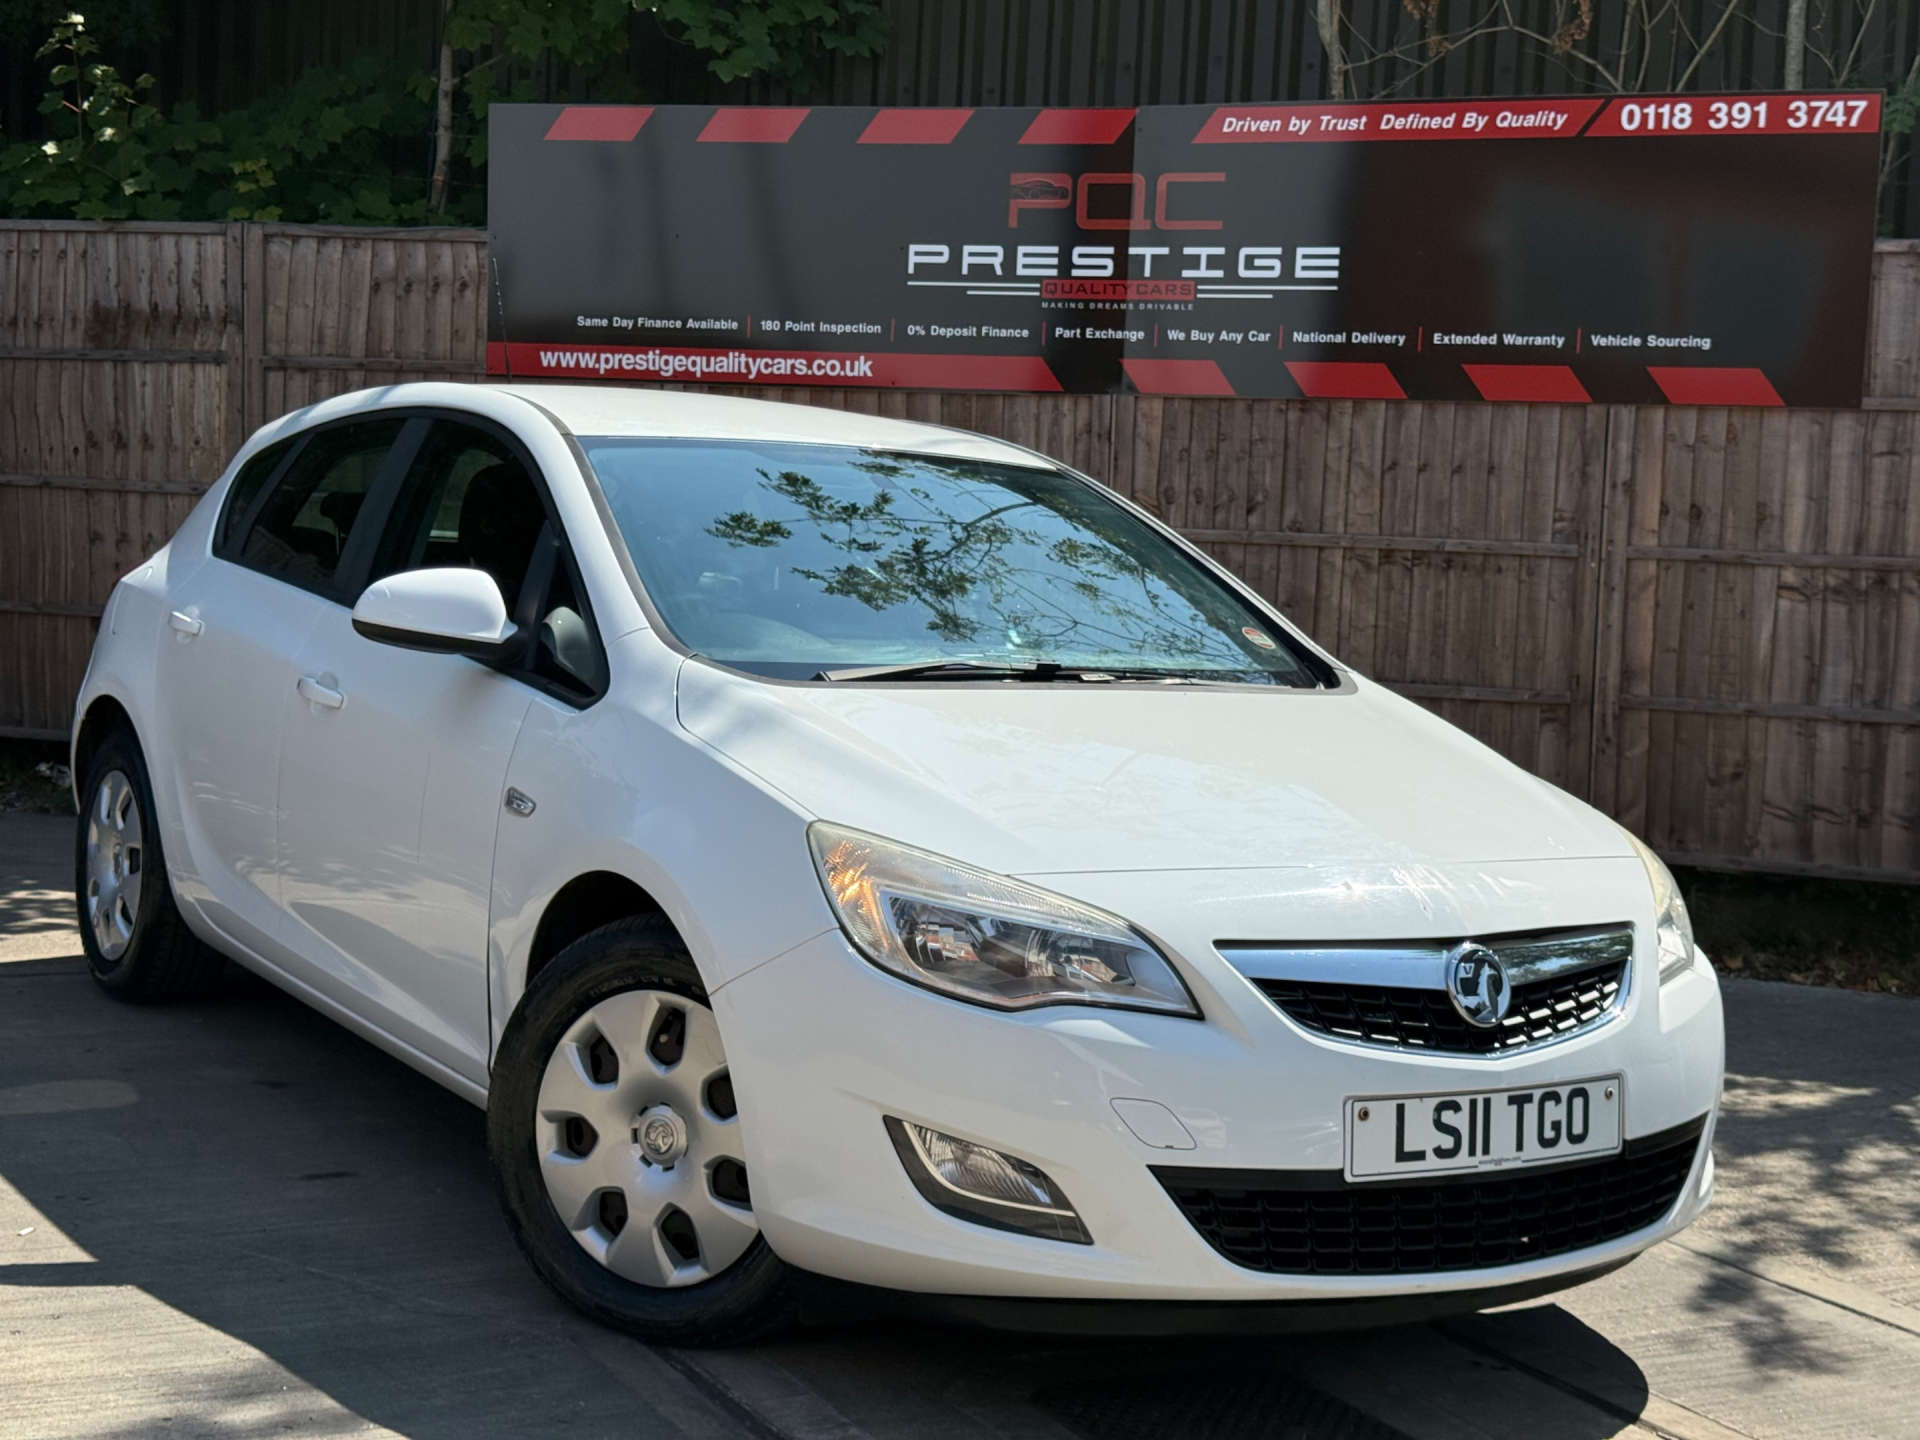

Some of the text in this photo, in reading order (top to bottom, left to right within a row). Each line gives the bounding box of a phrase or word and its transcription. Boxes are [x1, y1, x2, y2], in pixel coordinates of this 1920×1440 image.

[1222, 110, 1567, 135] Driven by Trust Defined By Quality
[1620, 100, 1868, 130] 0118 391 3747
[1008, 172, 1226, 230] PQC
[907, 243, 1341, 278] PRESTIGE
[1043, 282, 1193, 296] QUALITY CARS
[1041, 302, 1194, 311] MAKING DREAMS DRIVABLE
[576, 316, 738, 330] Same Day Finance Available
[760, 320, 882, 335] 180 Point Inspection
[907, 325, 1029, 339] 0% Deposit Finance
[1055, 327, 1145, 342] Part Exchange
[1167, 329, 1271, 344] We Buy Any Car
[1292, 331, 1406, 346] National Delivery
[1433, 333, 1565, 348] Extended Warranty
[1590, 334, 1711, 350] Vehicle Sourcing
[540, 348, 873, 380] www.prestigequalitycars.co.uk
[1394, 1086, 1590, 1163] LS11 TGO
